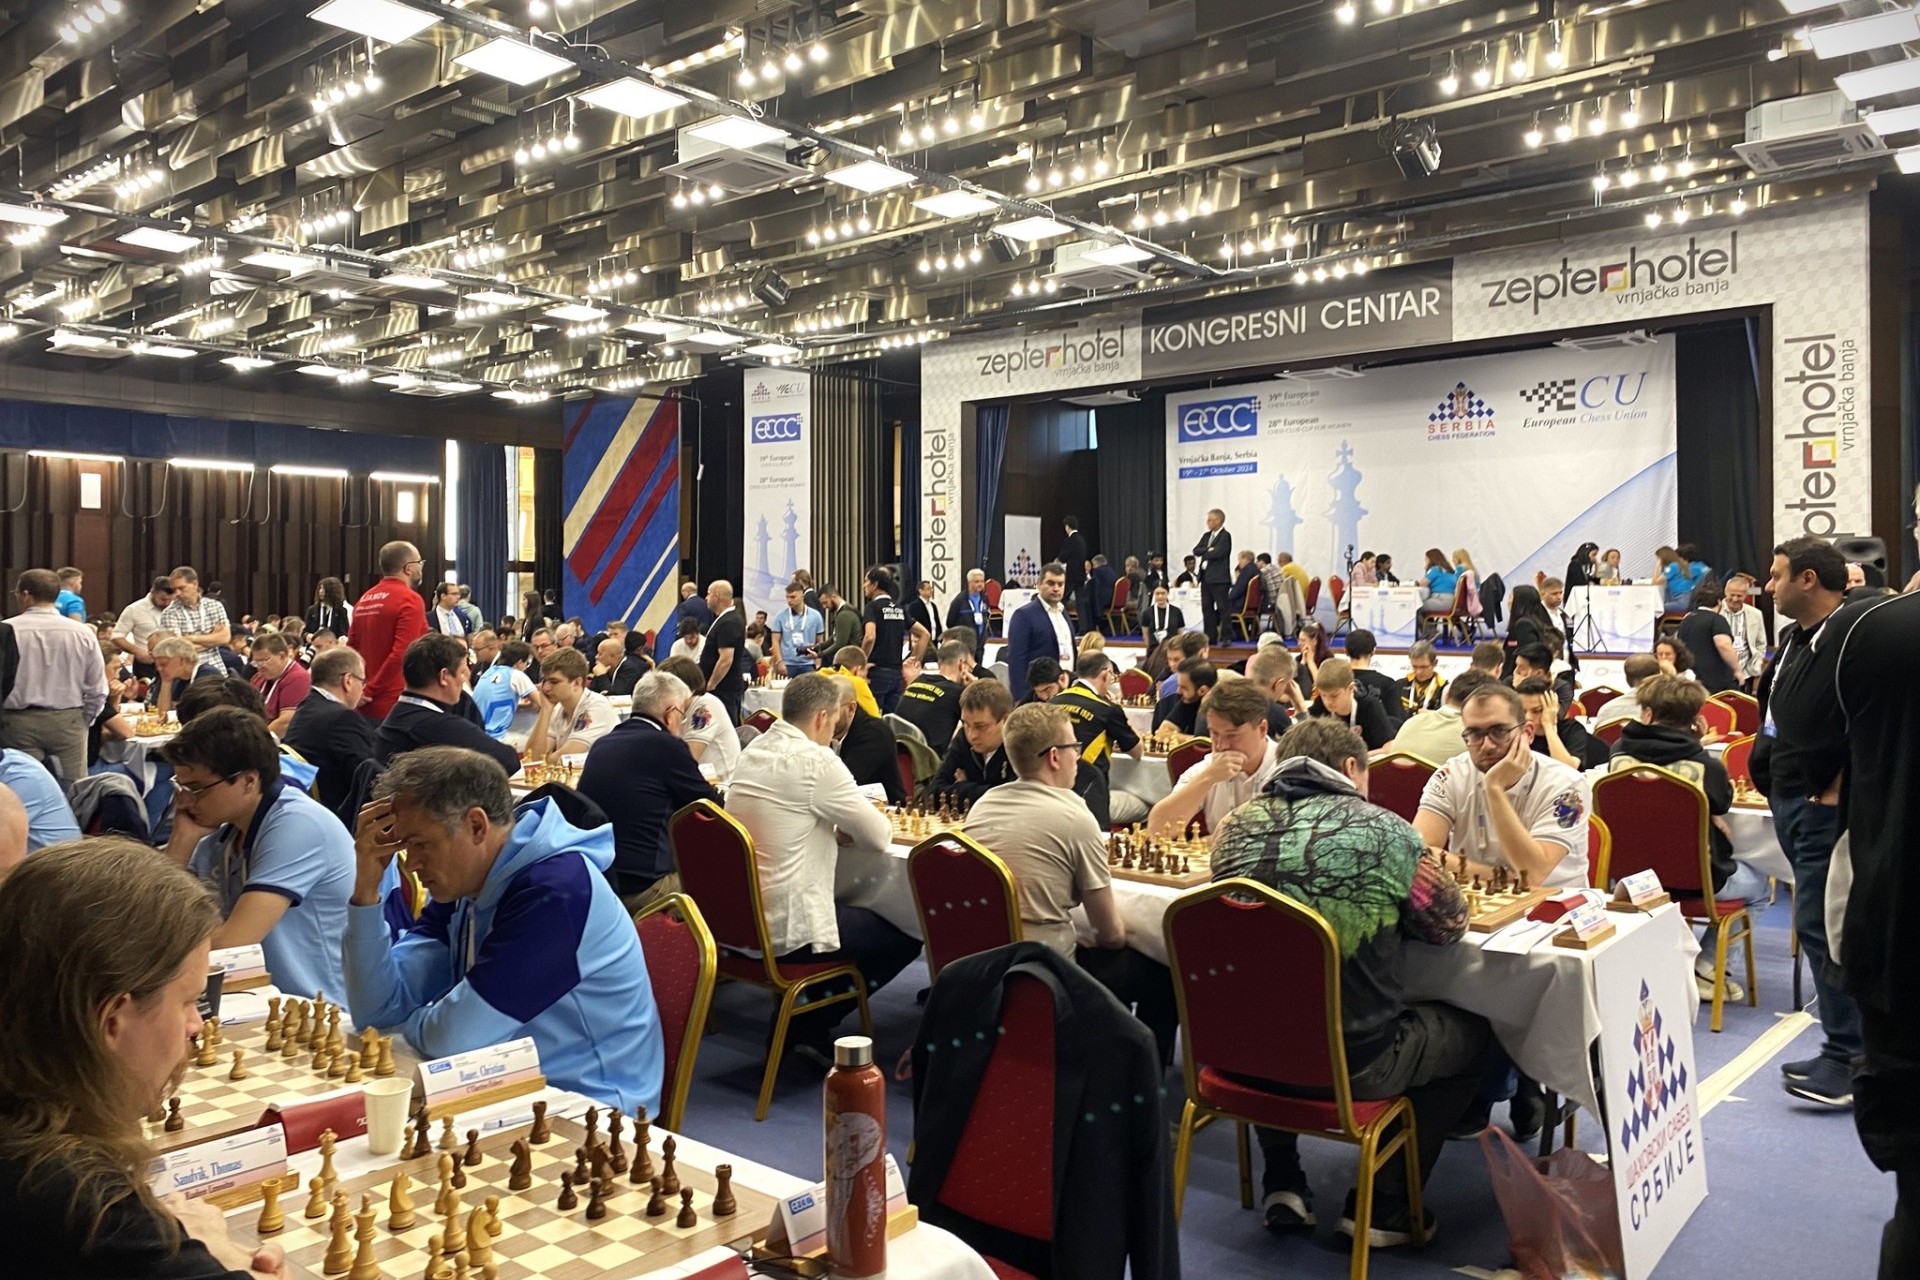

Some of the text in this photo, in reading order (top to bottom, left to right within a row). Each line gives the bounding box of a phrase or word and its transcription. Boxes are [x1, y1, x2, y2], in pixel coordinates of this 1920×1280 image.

[1616, 278, 1730, 306] vrnjačka banja
[1150, 286, 1441, 354] KONGRESNI CENTAR
[1094, 361, 1120, 374] banja
[1284, 390, 1320, 400] European
[1837, 339, 1859, 452] vrnjačka banja
[1283, 417, 1319, 427] European
[1427, 419, 1495, 434] SERBIA
[1522, 409, 1648, 429] European Chess Union
[1427, 430, 1496, 441] CHESS FEDERATION
[1784, 333, 1855, 538] pterhotel
[947, 432, 956, 461] banja
[1235, 450, 1258, 458] Serbia
[1210, 466, 1235, 475] October
[1236, 464, 1254, 473] 2024
[210, 1160, 243, 1178] Thomas
[1630, 1129, 1695, 1231] СРБИЈЕ
